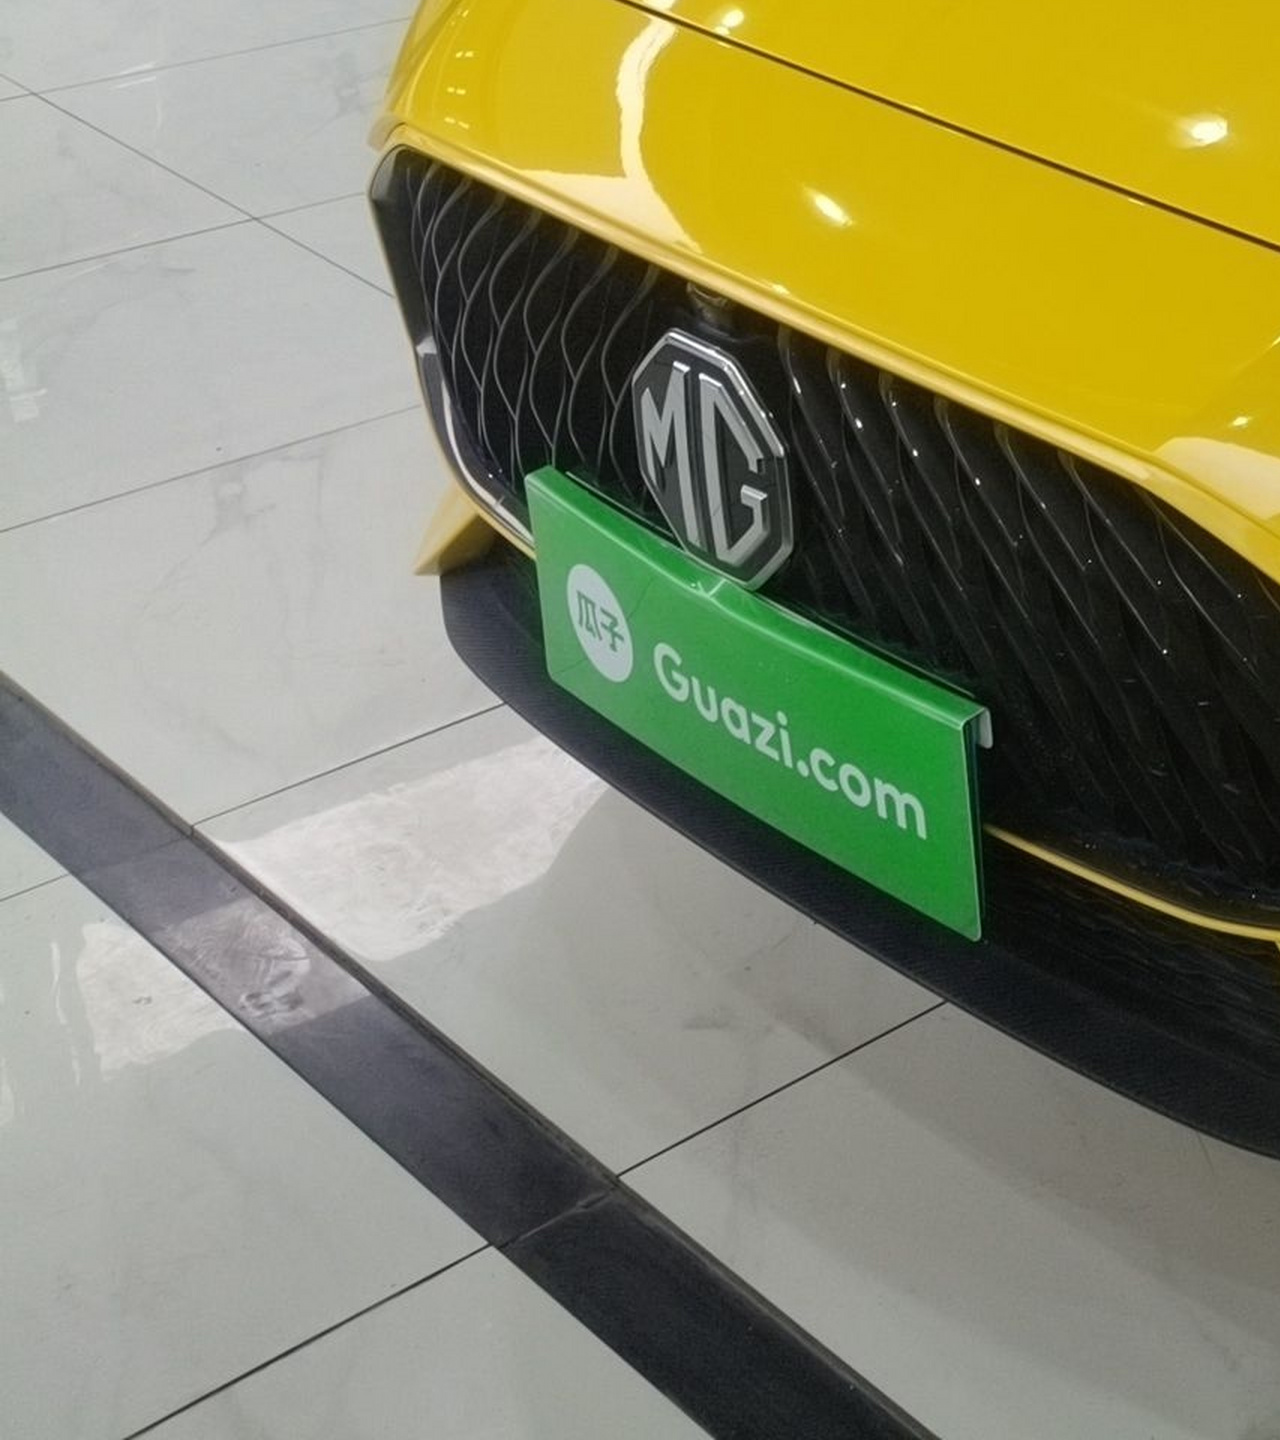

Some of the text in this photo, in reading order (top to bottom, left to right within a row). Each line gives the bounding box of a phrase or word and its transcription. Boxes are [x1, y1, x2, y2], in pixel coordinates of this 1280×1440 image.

[638, 359, 768, 568] MG
[576, 588, 625, 653] 瓜子
[653, 640, 929, 841] Guazi.com
